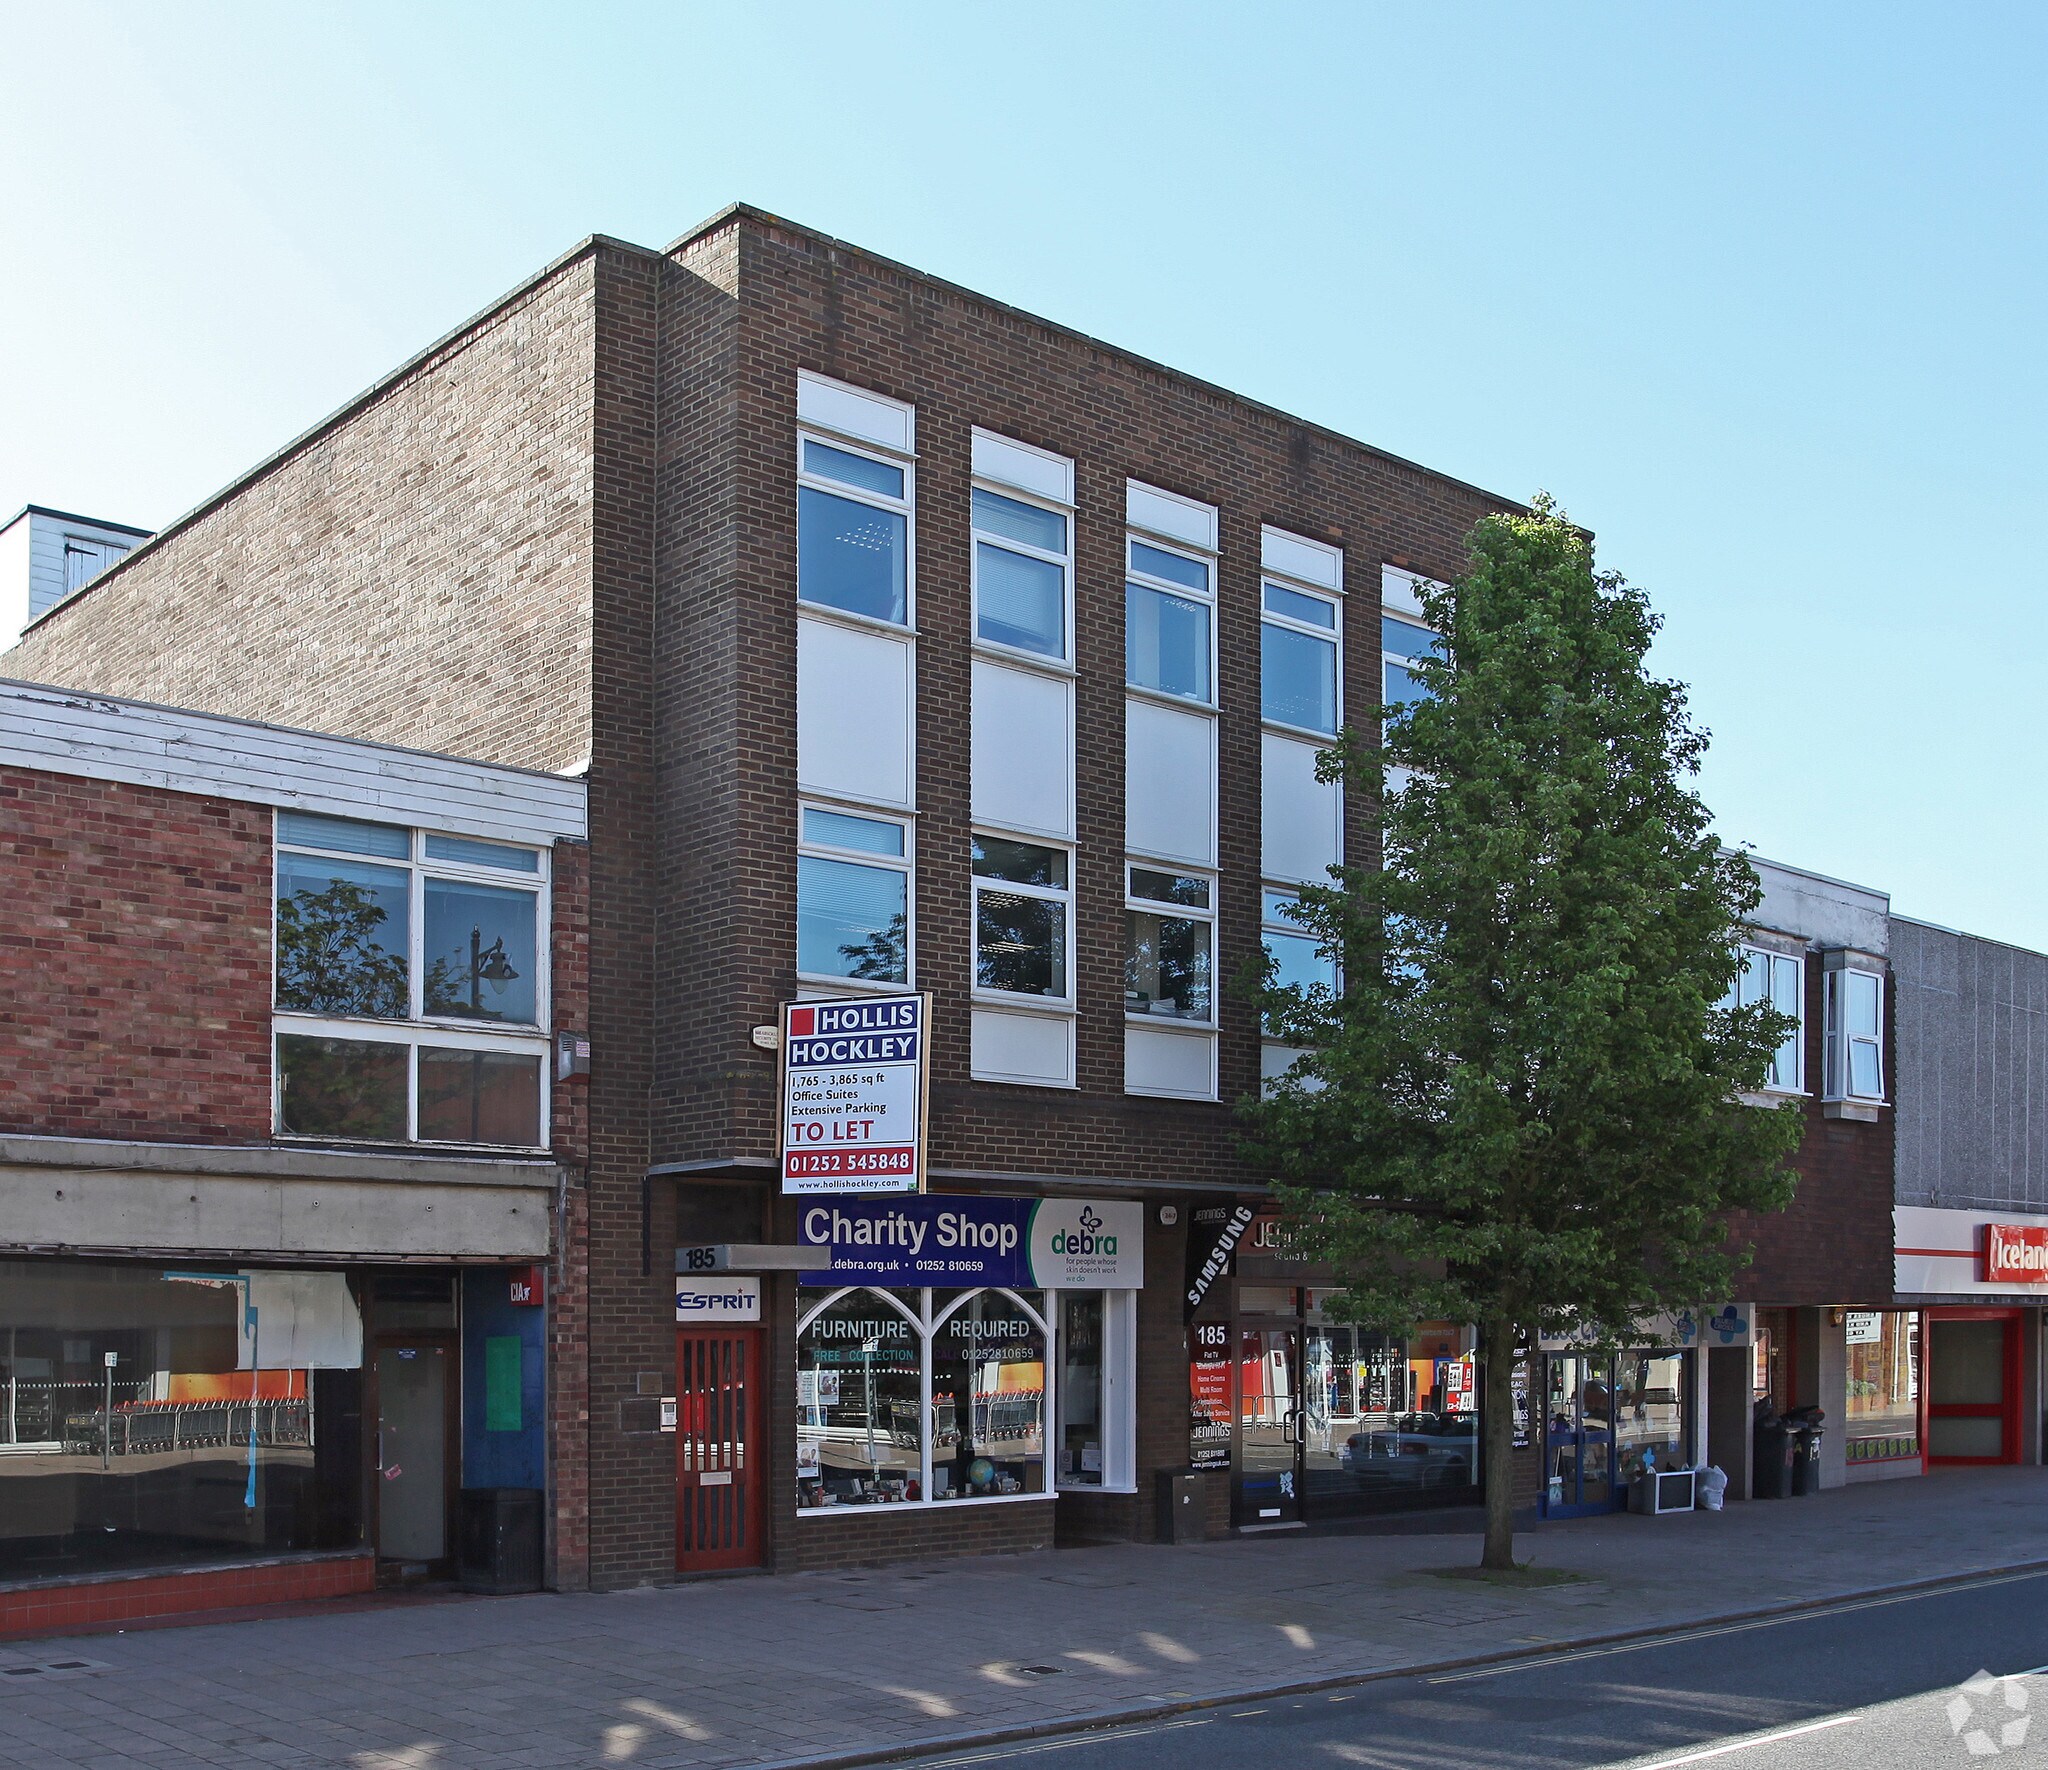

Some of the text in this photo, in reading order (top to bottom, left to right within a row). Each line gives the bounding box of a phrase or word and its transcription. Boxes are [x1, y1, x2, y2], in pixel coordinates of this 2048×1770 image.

[822, 1005, 914, 1030] HOLLIS
[792, 1036, 914, 1063] HOCKLEY
[792, 1076, 819, 1088] 1,765
[829, 1074, 858, 1086] 3,865
[861, 1076, 873, 1086] sq
[876, 1073, 885, 1082] ft
[792, 1089, 858, 1101] Office Suites
[792, 1102, 887, 1116] Extensive Parking
[792, 1120, 874, 1141] TO LET
[790, 1153, 909, 1172] 01252 545848
[798, 1179, 900, 1189] www.hollishockley.com
[805, 1207, 1018, 1257] Charity Shop
[1051, 1229, 1117, 1255] debra
[686, 1247, 716, 1269] 185
[1188, 1206, 1252, 1305] SAMSUNG
[829, 1258, 984, 1273] .debra.org.uk 01252 810659
[812, 1320, 1030, 1340] FURNITURE REQUIRED
[1198, 1326, 1226, 1345] 185
[813, 1350, 840, 1361] FREE
[961, 1348, 1034, 1360] 01252810659
